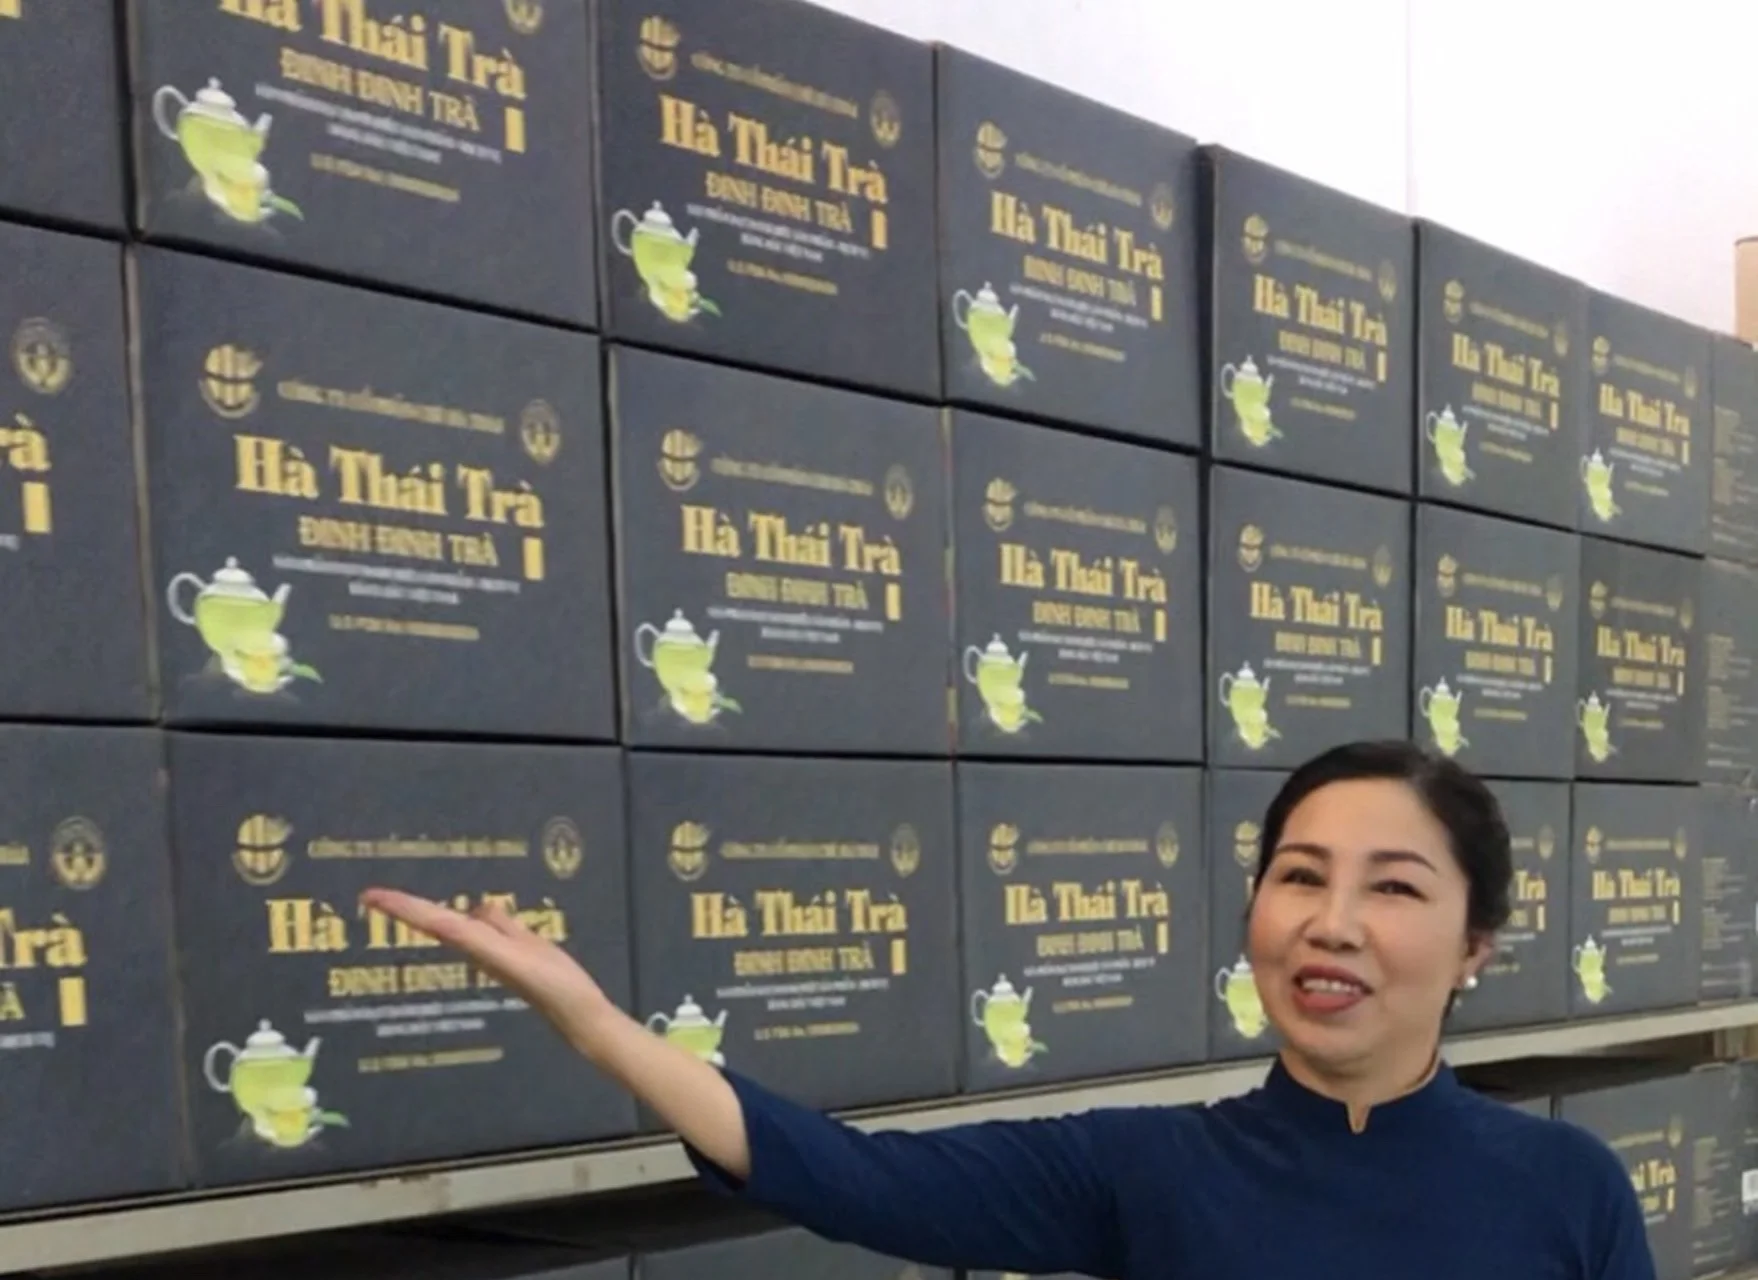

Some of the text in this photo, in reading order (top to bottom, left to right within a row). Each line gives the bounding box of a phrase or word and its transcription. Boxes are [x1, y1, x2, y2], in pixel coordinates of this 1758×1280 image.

[319, 0, 428, 71] Thái
[437, 22, 527, 100] Trà
[428, 90, 481, 132] TRÀ
[660, 93, 888, 205] Hà Thái Trà
[990, 189, 1164, 280] Hà Thái Trà
[1253, 272, 1387, 346] Hà Thái Trà
[234, 433, 545, 529] Hà Thái Trà
[680, 504, 902, 576] Hà Thái Trà
[1000, 543, 1167, 603] Hà Thái Trà
[265, 898, 349, 954] Hà
[690, 887, 908, 939] Hà Thái Trà
[1004, 879, 1170, 926] Hà Thái Trà
